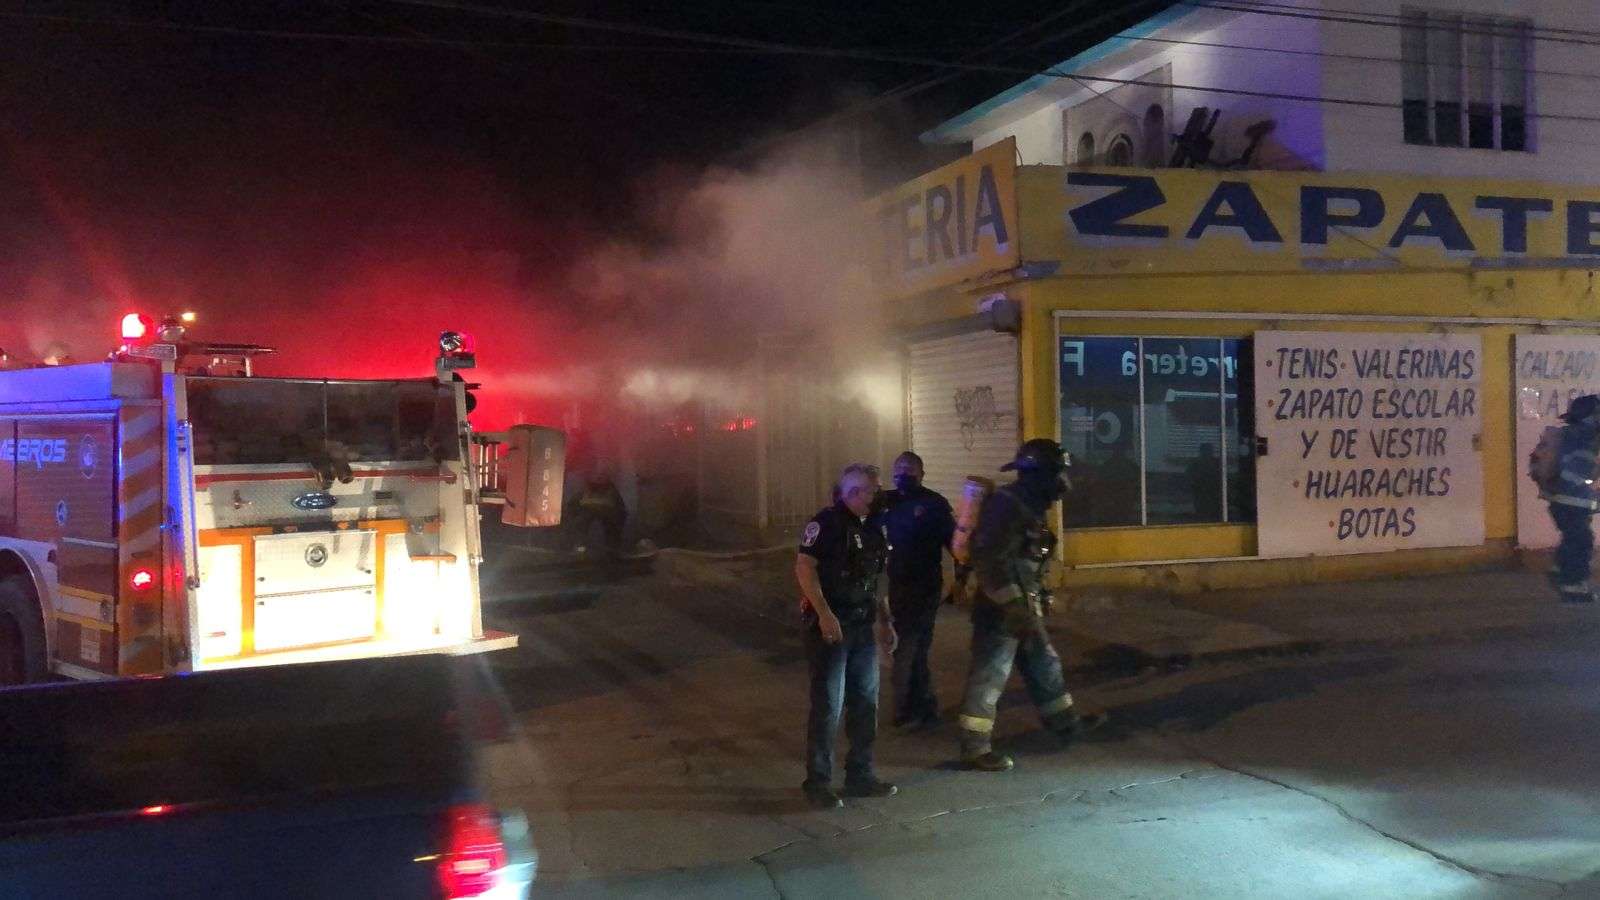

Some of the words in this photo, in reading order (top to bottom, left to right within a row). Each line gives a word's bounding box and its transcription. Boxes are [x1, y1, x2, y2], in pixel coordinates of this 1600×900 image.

[1276, 348, 1338, 379] TENIS
[1351, 348, 1475, 379] VALERINAS
[1275, 388, 1363, 420] ZAPATO
[1371, 388, 1476, 419] ESCOLAR
[1301, 430, 1319, 459] Y
[1329, 428, 1358, 459] DE
[1369, 427, 1447, 459] VESTIR
[1305, 467, 1452, 499] HUARACHES
[1337, 507, 1416, 540] BOTAS
